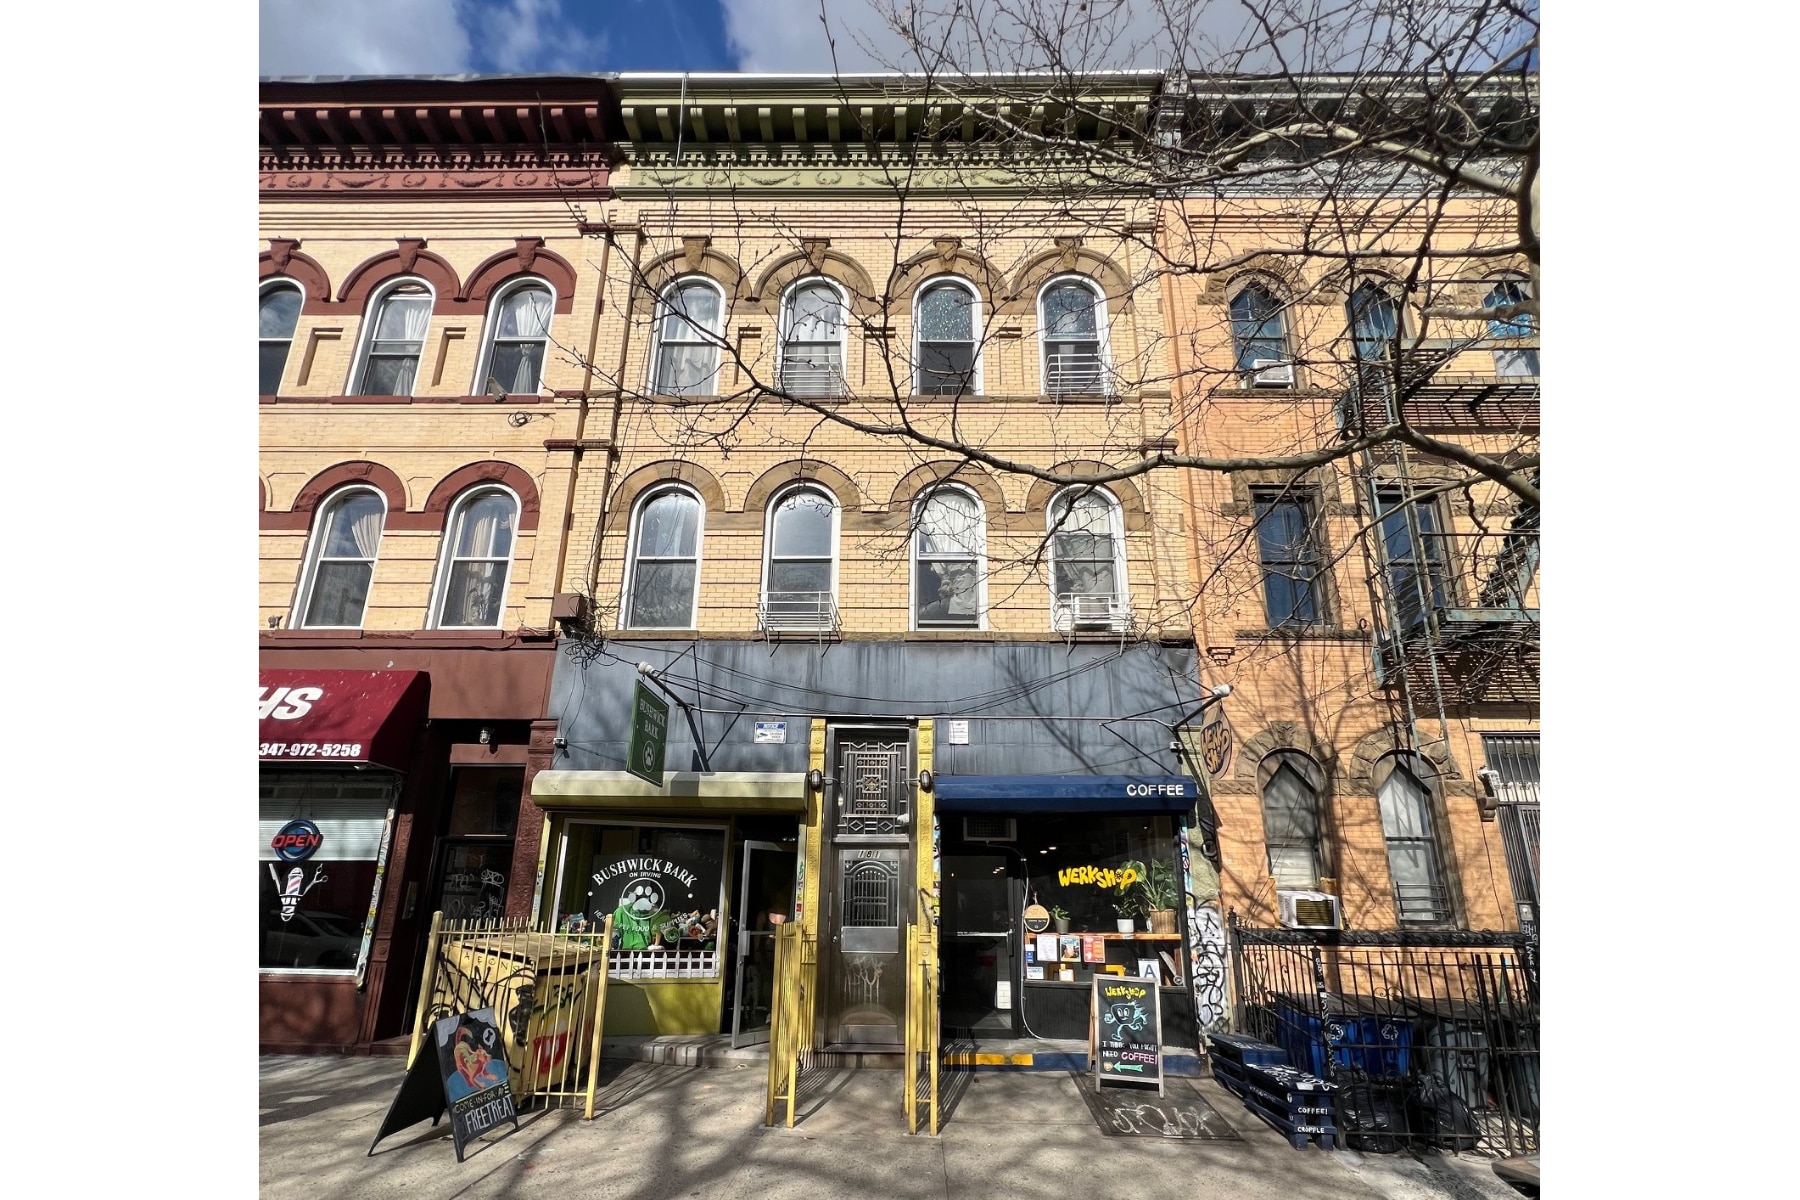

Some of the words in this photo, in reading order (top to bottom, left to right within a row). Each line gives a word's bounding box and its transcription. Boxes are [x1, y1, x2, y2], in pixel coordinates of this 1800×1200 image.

[644, 719, 659, 740] BARK
[258, 743, 362, 757] 347-972-5258
[1126, 783, 1184, 797] COFFEE
[271, 834, 320, 849] OPEN
[859, 850, 880, 858] 181
[592, 858, 663, 886] BUSHWICK
[663, 861, 698, 888] BARK
[1058, 864, 1137, 890] WERKSHOP
[1144, 964, 1157, 978] A
[1104, 986, 1146, 1000] WERKSHOP
[1102, 1040, 1107, 1048] I
[1102, 1050, 1119, 1058] NEED
[1121, 1051, 1158, 1065] COFFEE!
[1297, 1107, 1328, 1115] COFFEE!
